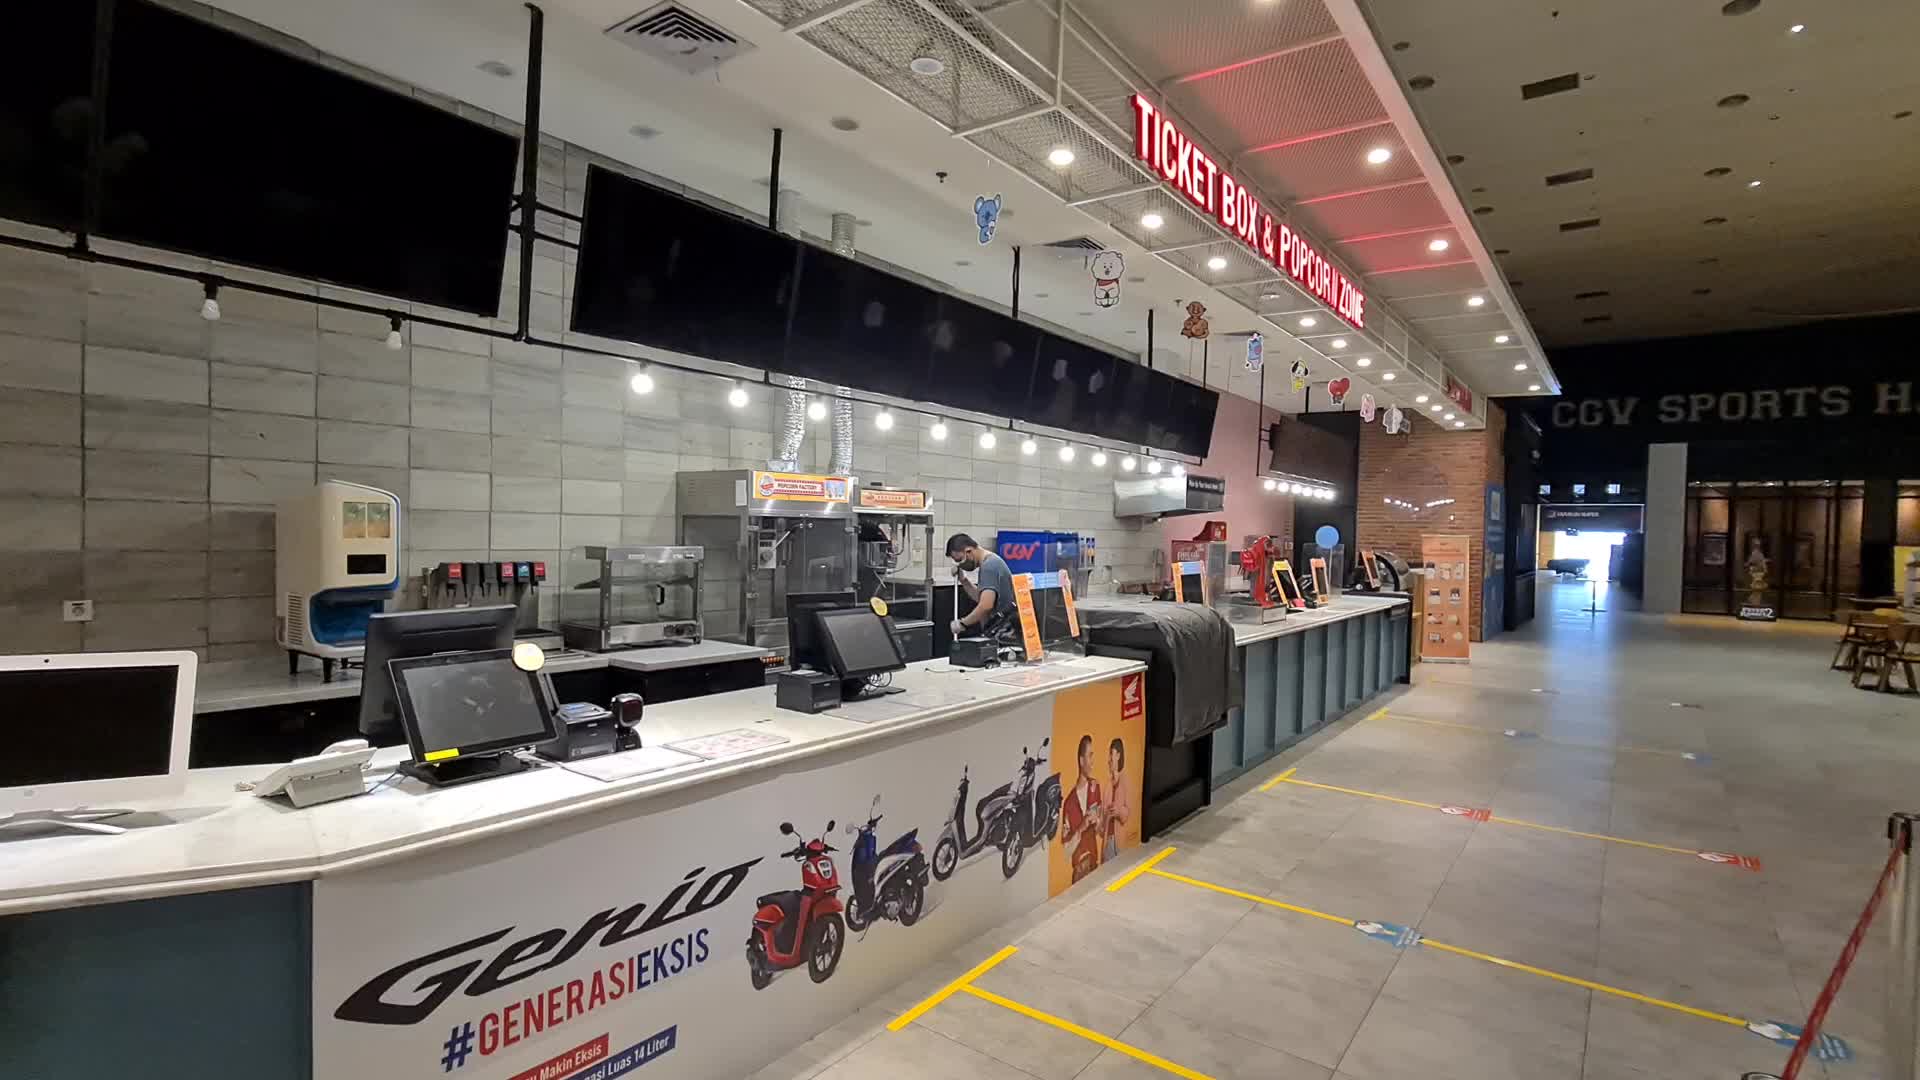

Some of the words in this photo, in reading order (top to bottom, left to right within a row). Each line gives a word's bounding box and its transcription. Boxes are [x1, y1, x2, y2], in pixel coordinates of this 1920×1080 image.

[1132, 92, 1217, 213] TICKET
[1217, 173, 1258, 250] BOX
[1260, 214, 1275, 258] &
[1278, 223, 1338, 313] POPCORN
[1338, 277, 1366, 328] ZONE
[1551, 397, 1640, 428] CGV
[1656, 385, 1852, 423] SPORTS
[1873, 381, 1920, 415] H
[1003, 541, 1040, 560] CGV
[334, 856, 764, 1025] Genio
[440, 928, 709, 1072] #GENERASIEKSIS
[540, 1056, 573, 1080] Makin
[575, 1043, 602, 1065] Eksis
[608, 1055, 632, 1075] Luas
[634, 1046, 645, 1062] 14
[647, 1036, 669, 1056] Liter
